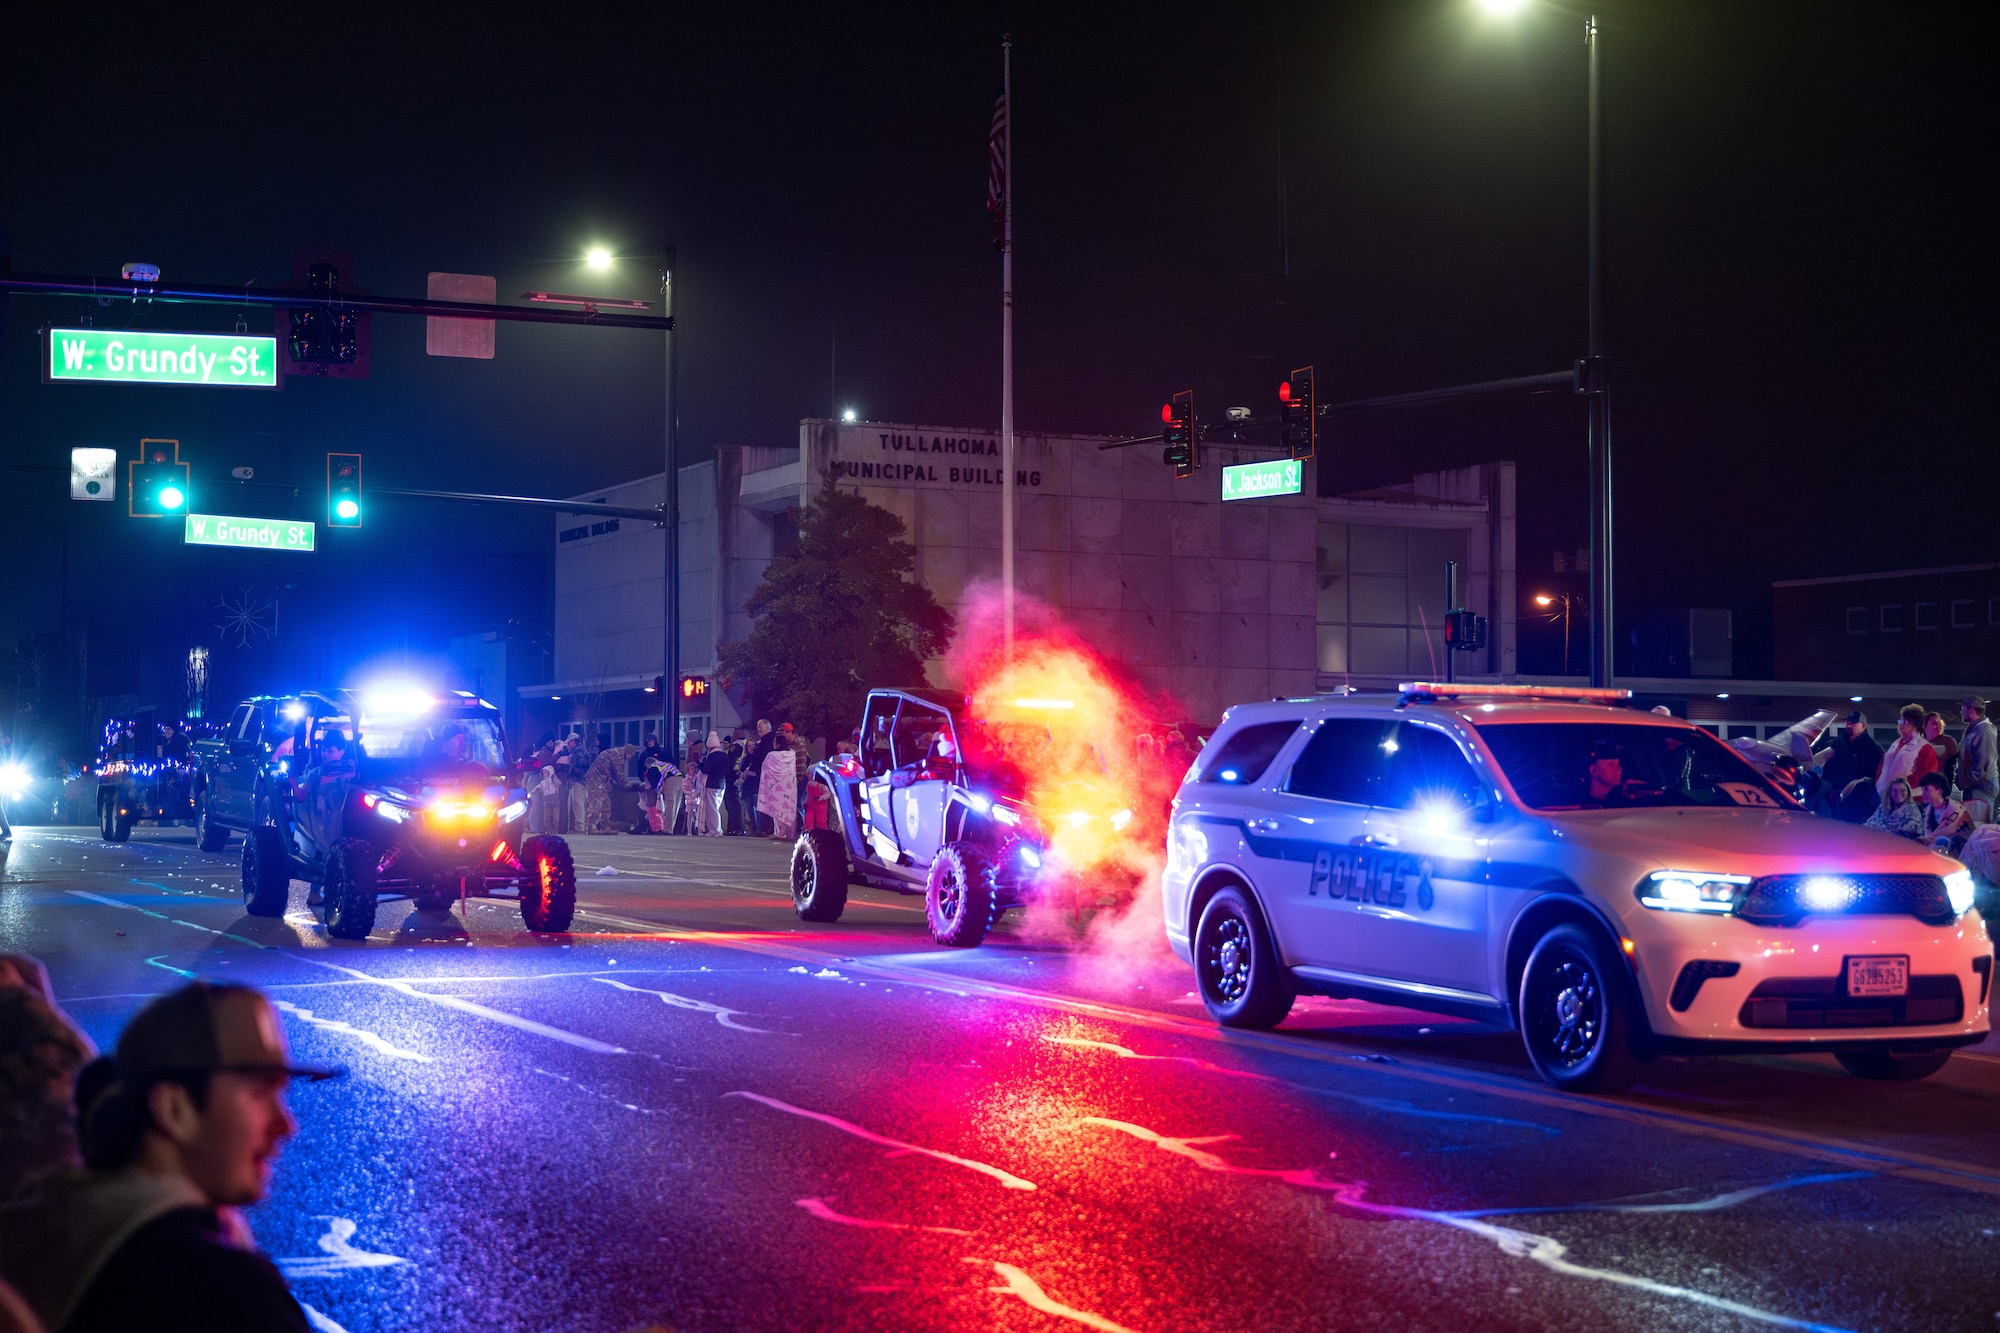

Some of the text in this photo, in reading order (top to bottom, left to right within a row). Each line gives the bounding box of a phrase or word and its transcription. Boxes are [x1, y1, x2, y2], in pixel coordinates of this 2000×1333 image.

[61, 339, 266, 382] W. Grundy St.
[879, 434, 999, 456] TULLAHOMA
[949, 466, 1042, 487] BUILDNG
[1224, 473, 1235, 494] N.
[1238, 469, 1281, 493] Jackson
[191, 519, 309, 547] W. Grundy St.
[1734, 789, 1768, 804] 72
[1309, 848, 1411, 909] POLICE
